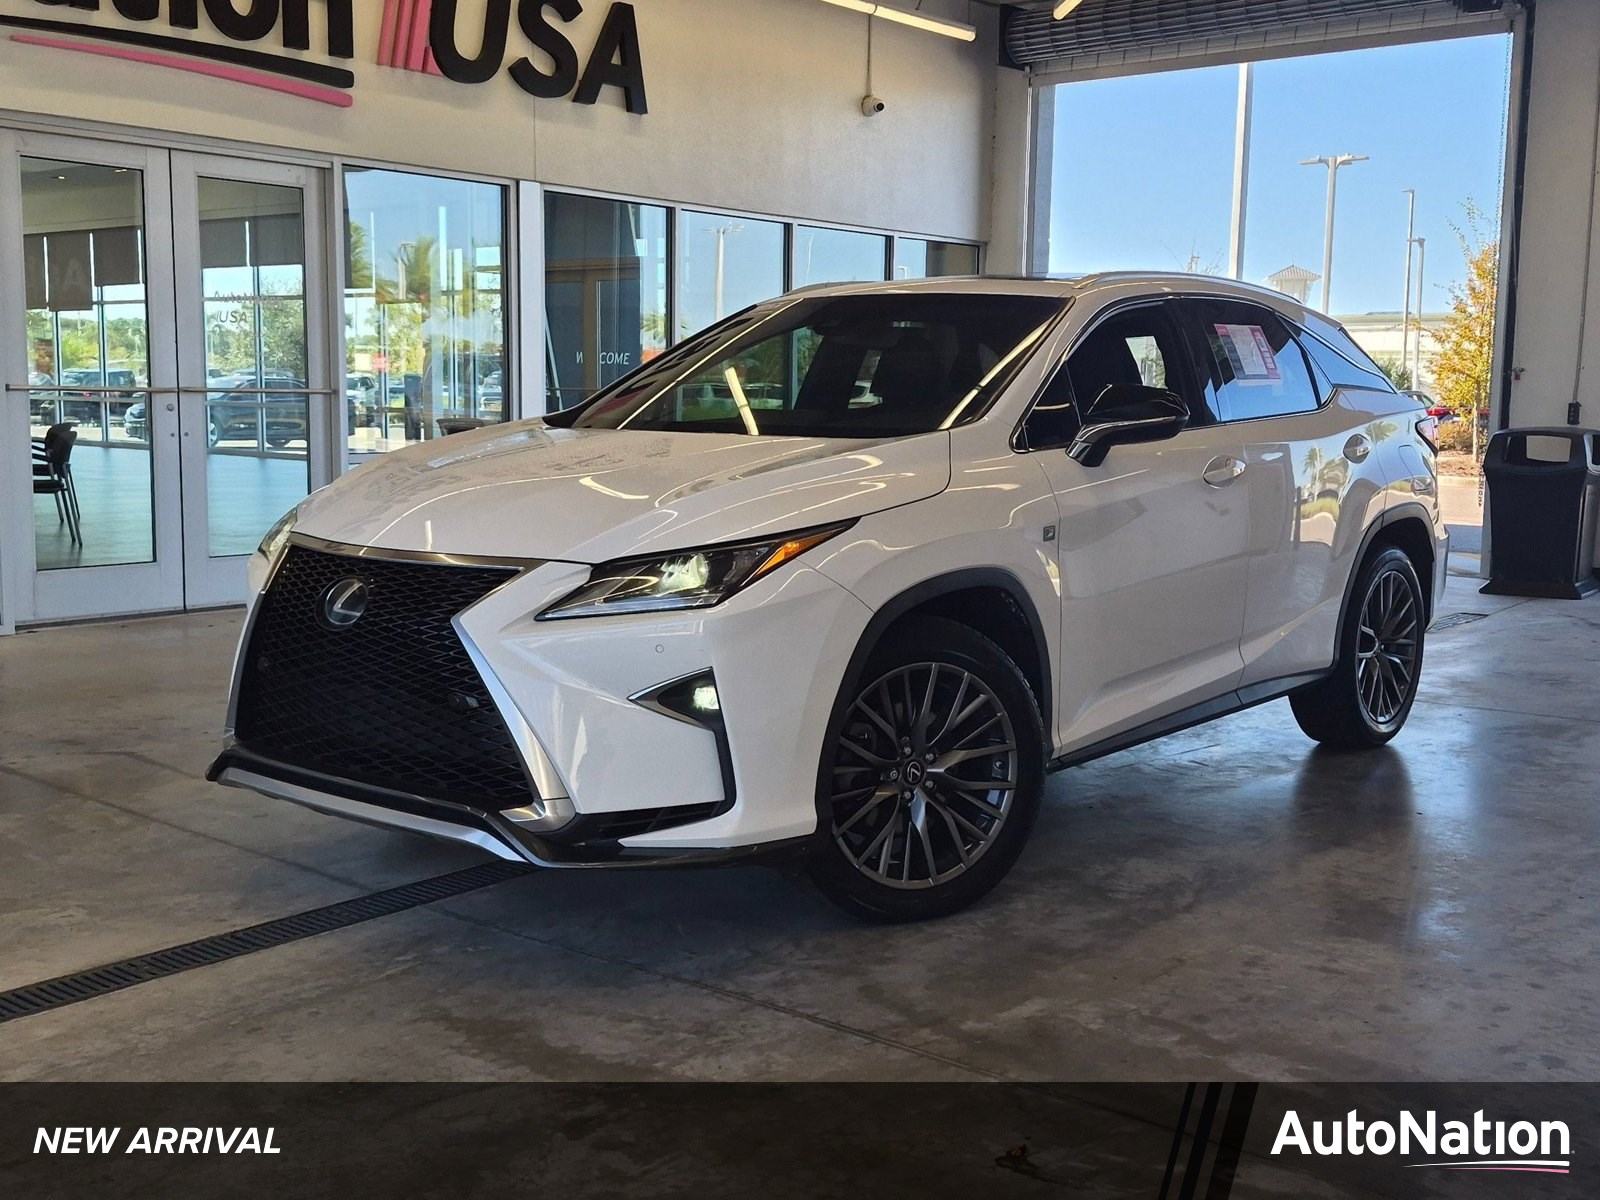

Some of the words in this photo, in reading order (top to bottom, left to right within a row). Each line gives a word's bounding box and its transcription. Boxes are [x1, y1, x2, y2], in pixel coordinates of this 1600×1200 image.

[429, 0, 648, 115] USA
[218, 310, 248, 324] USA
[576, 351, 630, 365] WCOME
